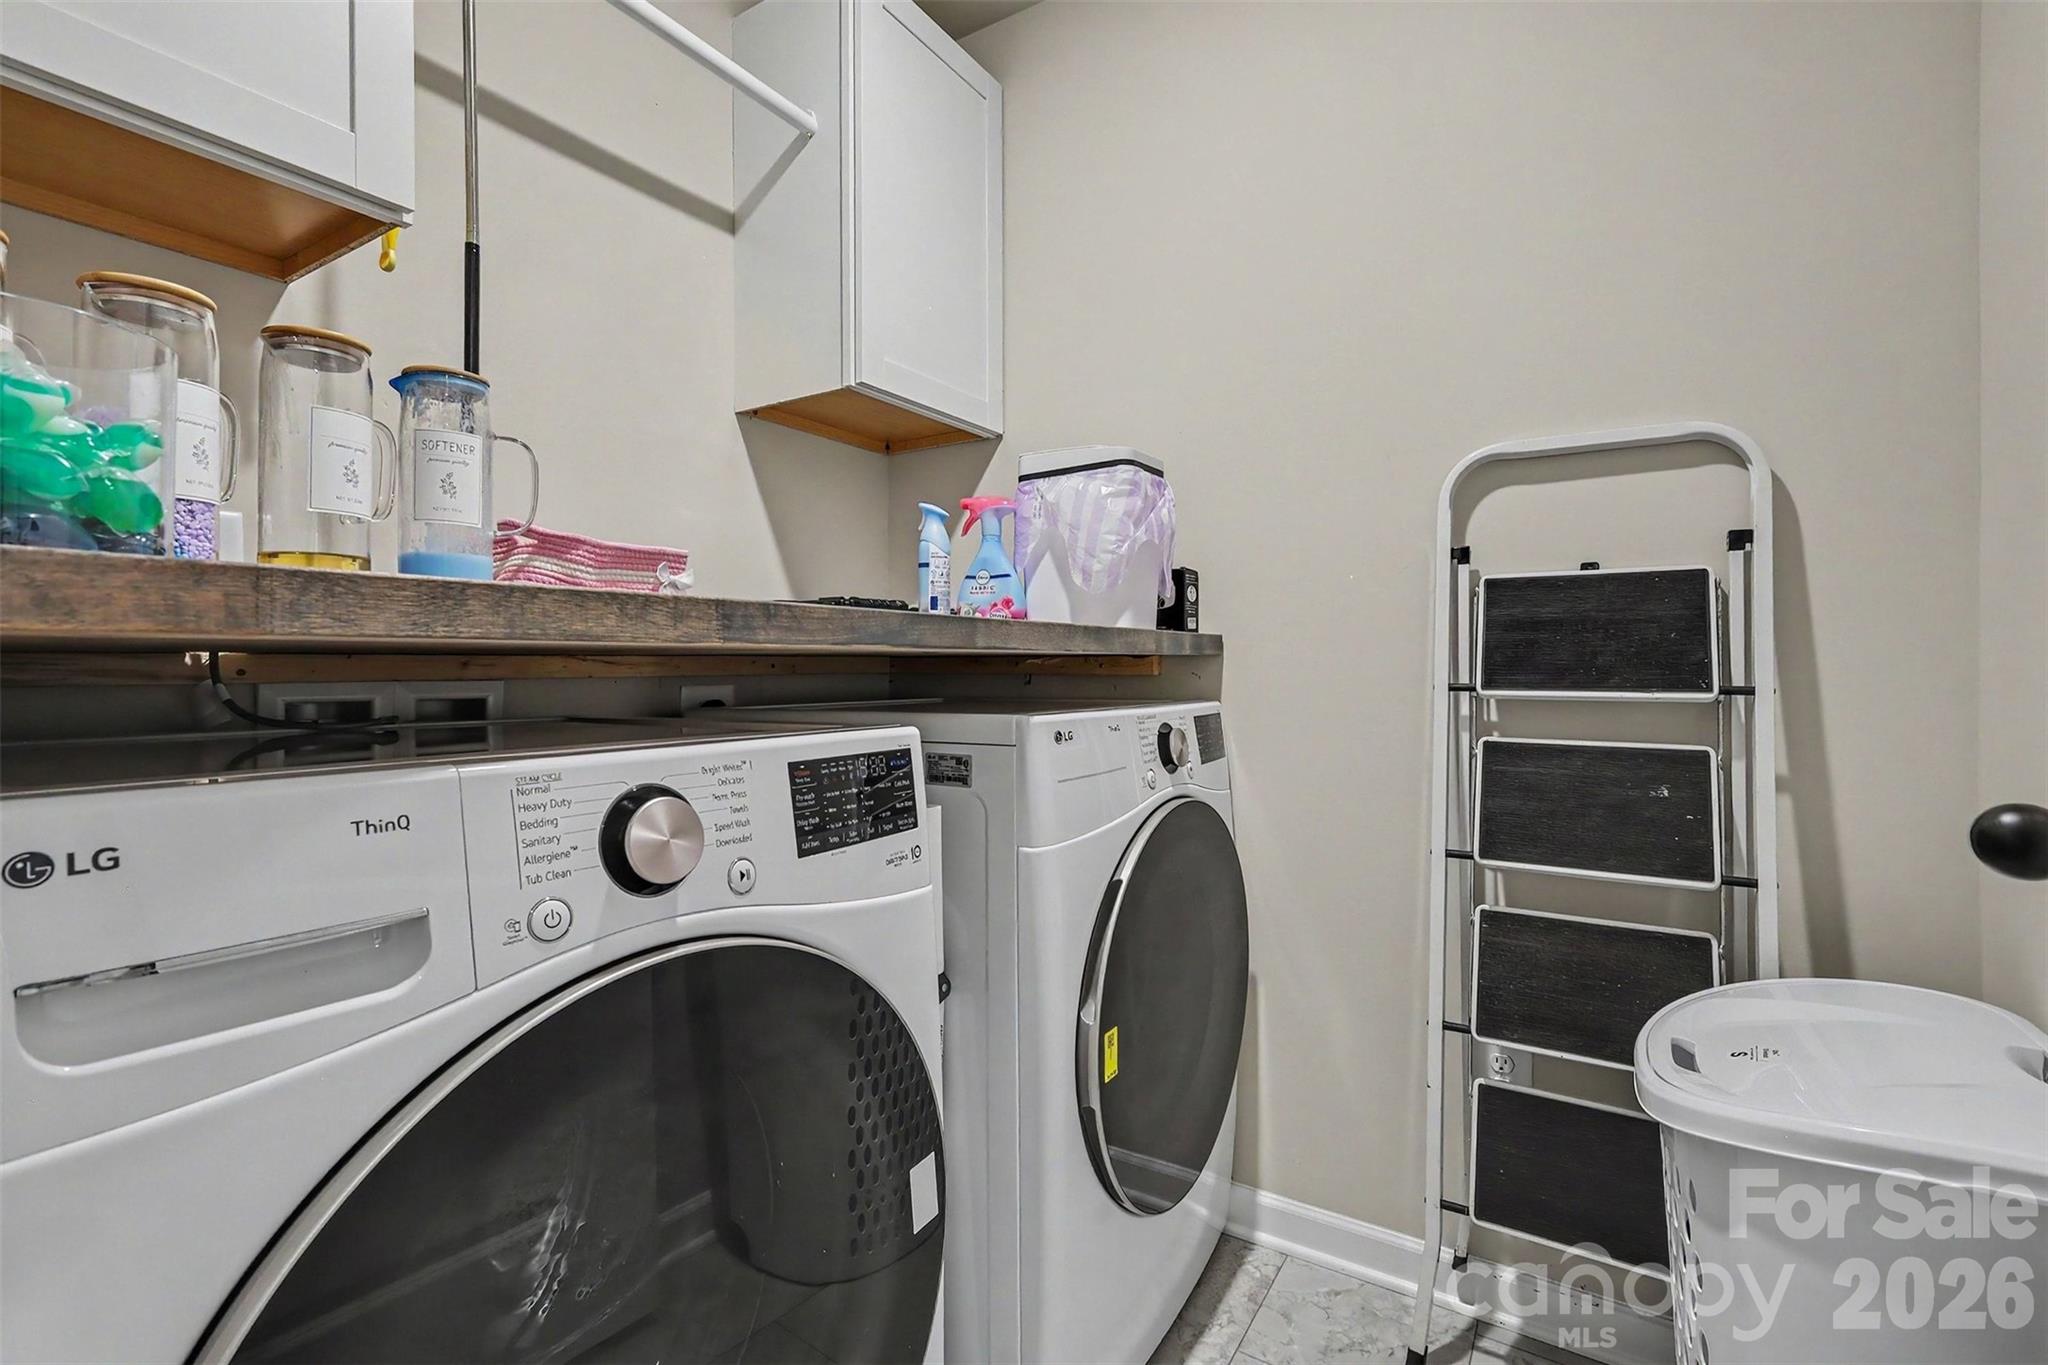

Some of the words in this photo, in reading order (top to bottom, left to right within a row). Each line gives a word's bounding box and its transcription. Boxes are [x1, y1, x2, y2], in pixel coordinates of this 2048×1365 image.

[421, 439, 476, 456] SOFTENER
[1062, 730, 1074, 742] LG
[516, 784, 551, 797] Normal
[518, 802, 548, 813] Heavy
[550, 798, 573, 809] Duty
[349, 814, 411, 837] ThinQ
[520, 817, 559, 831] Bedding
[521, 834, 562, 849] Sanitary
[65, 847, 121, 877] LG
[526, 873, 543, 885] Tub
[545, 869, 572, 881] Clean
